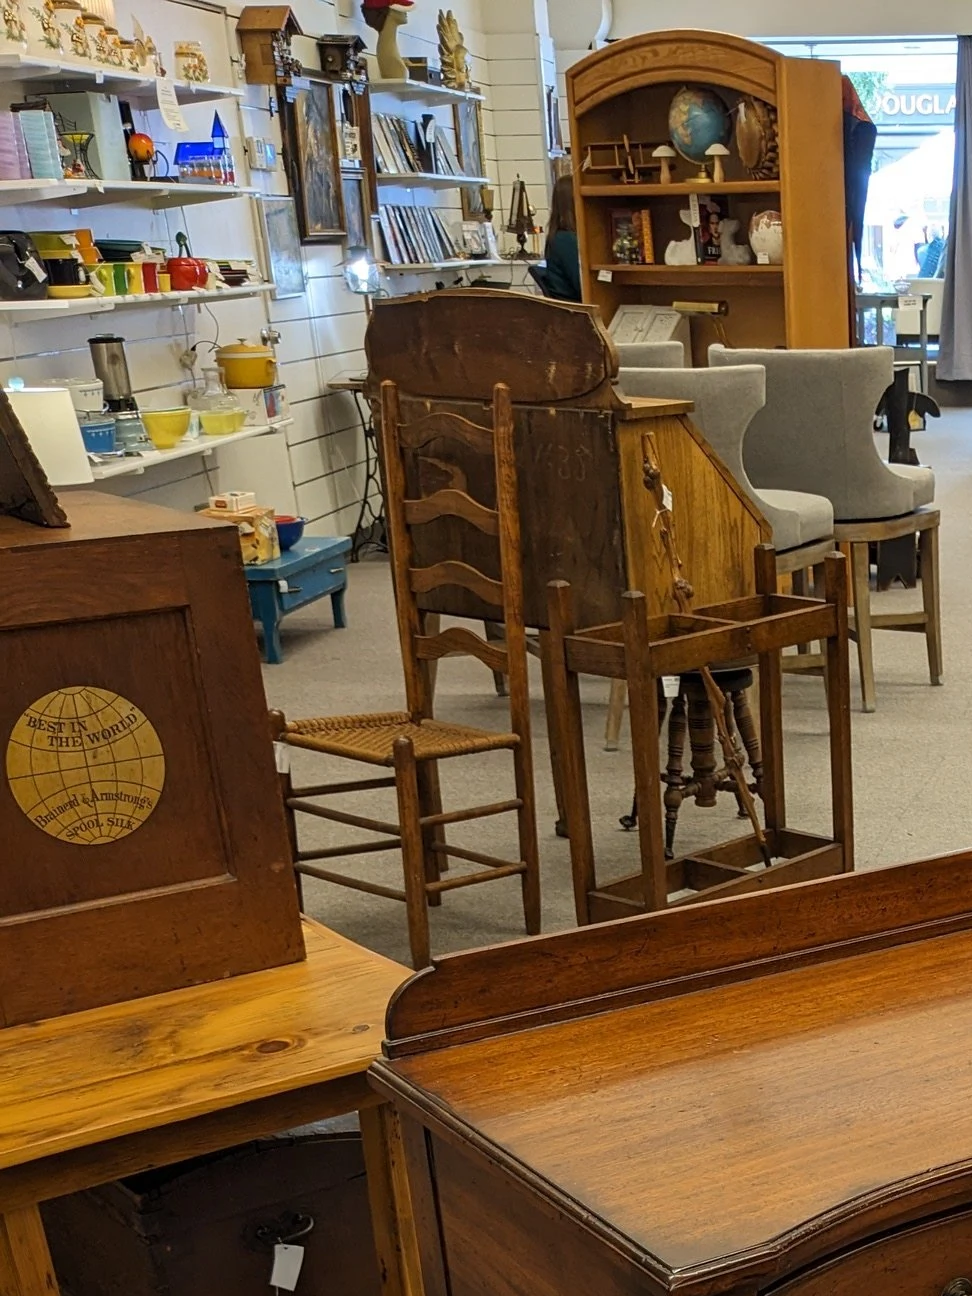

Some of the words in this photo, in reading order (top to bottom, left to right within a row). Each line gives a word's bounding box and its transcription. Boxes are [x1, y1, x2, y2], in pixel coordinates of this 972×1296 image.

[870, 93, 956, 116] DOUGLA
[70, 721, 88, 733] IN
[47, 735, 82, 747] THE
[34, 794, 80, 828] Brainerd
[80, 793, 94, 808] &
[66, 818, 104, 840] SPOOL
[107, 817, 136, 831] SILK
